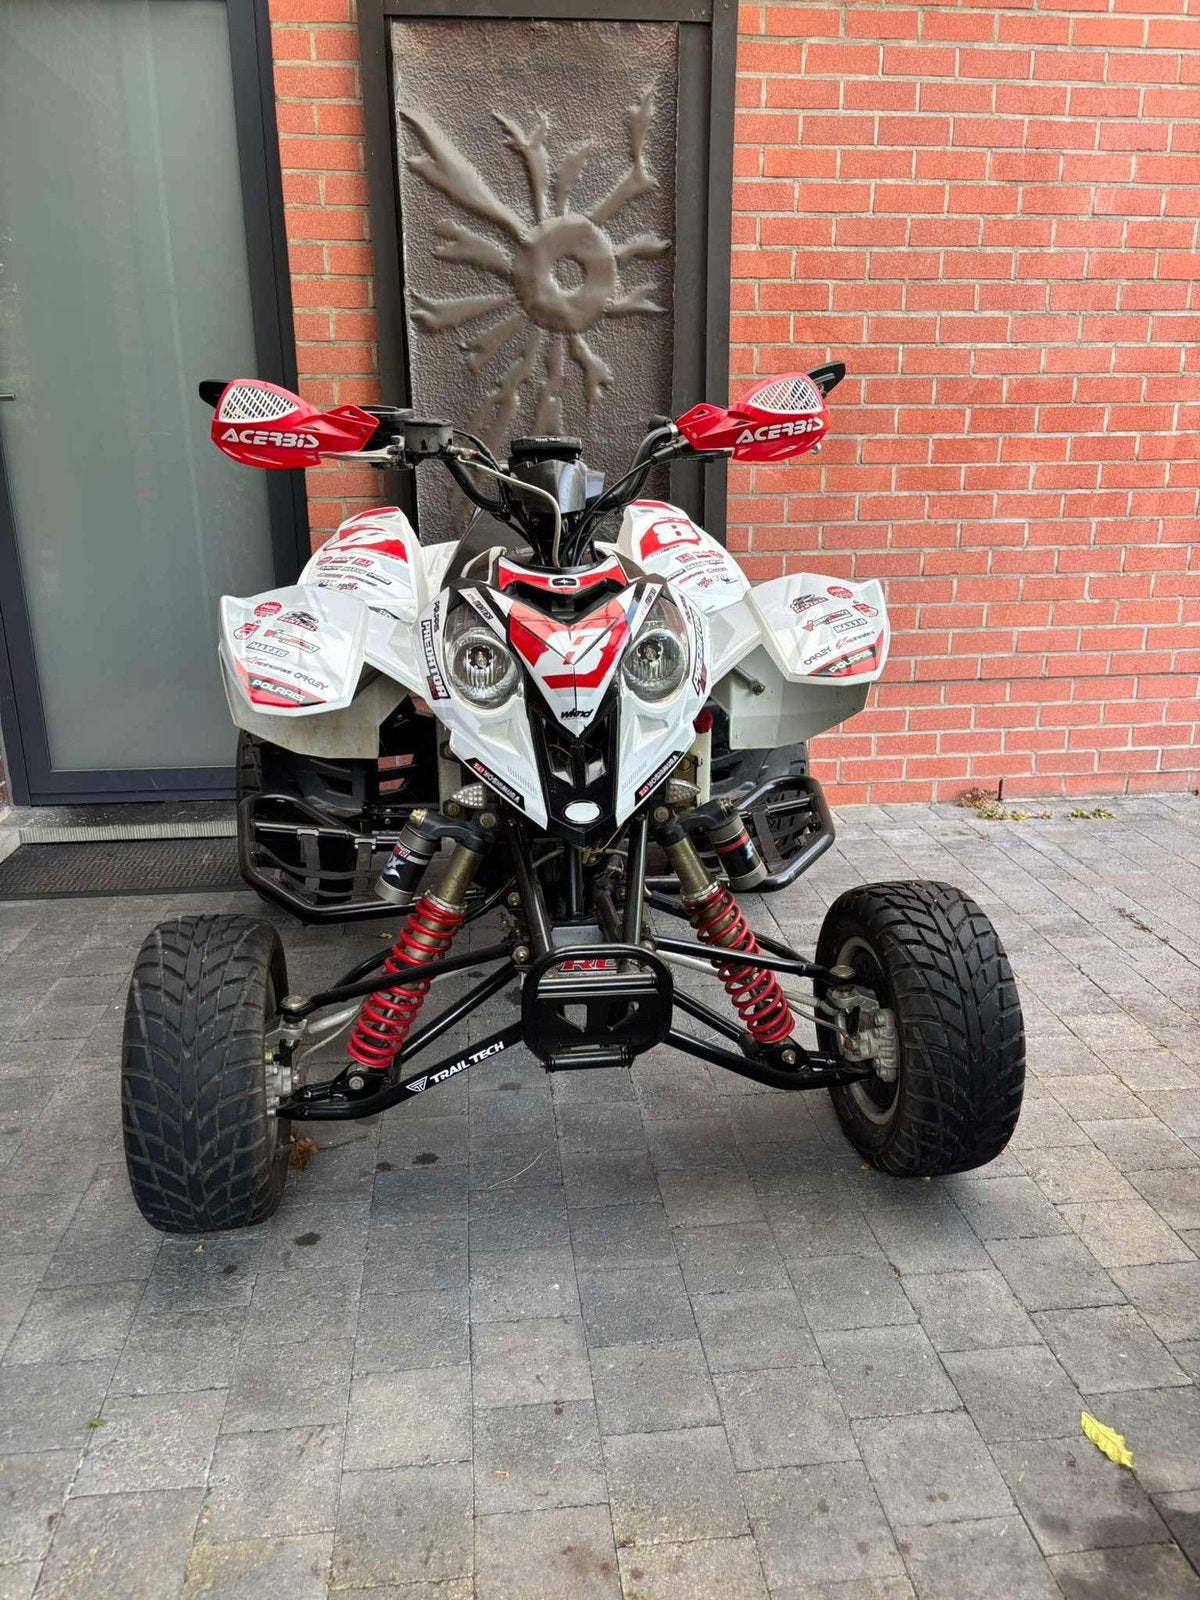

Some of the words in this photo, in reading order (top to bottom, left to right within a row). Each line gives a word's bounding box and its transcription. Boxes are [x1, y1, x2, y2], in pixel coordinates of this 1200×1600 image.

[221, 428, 319, 448] ACERBIS
[736, 417, 824, 444] ACERBIS
[247, 642, 289, 657] MAXXIS
[421, 620, 449, 698] PREDATOR
[804, 645, 832, 665] OAKLEY
[828, 649, 873, 673] POLARIS
[252, 679, 306, 702] POLARIS
[294, 672, 329, 690] OAKLEY
[430, 1060, 470, 1083] TRAIL
[469, 1041, 504, 1063] TECH
